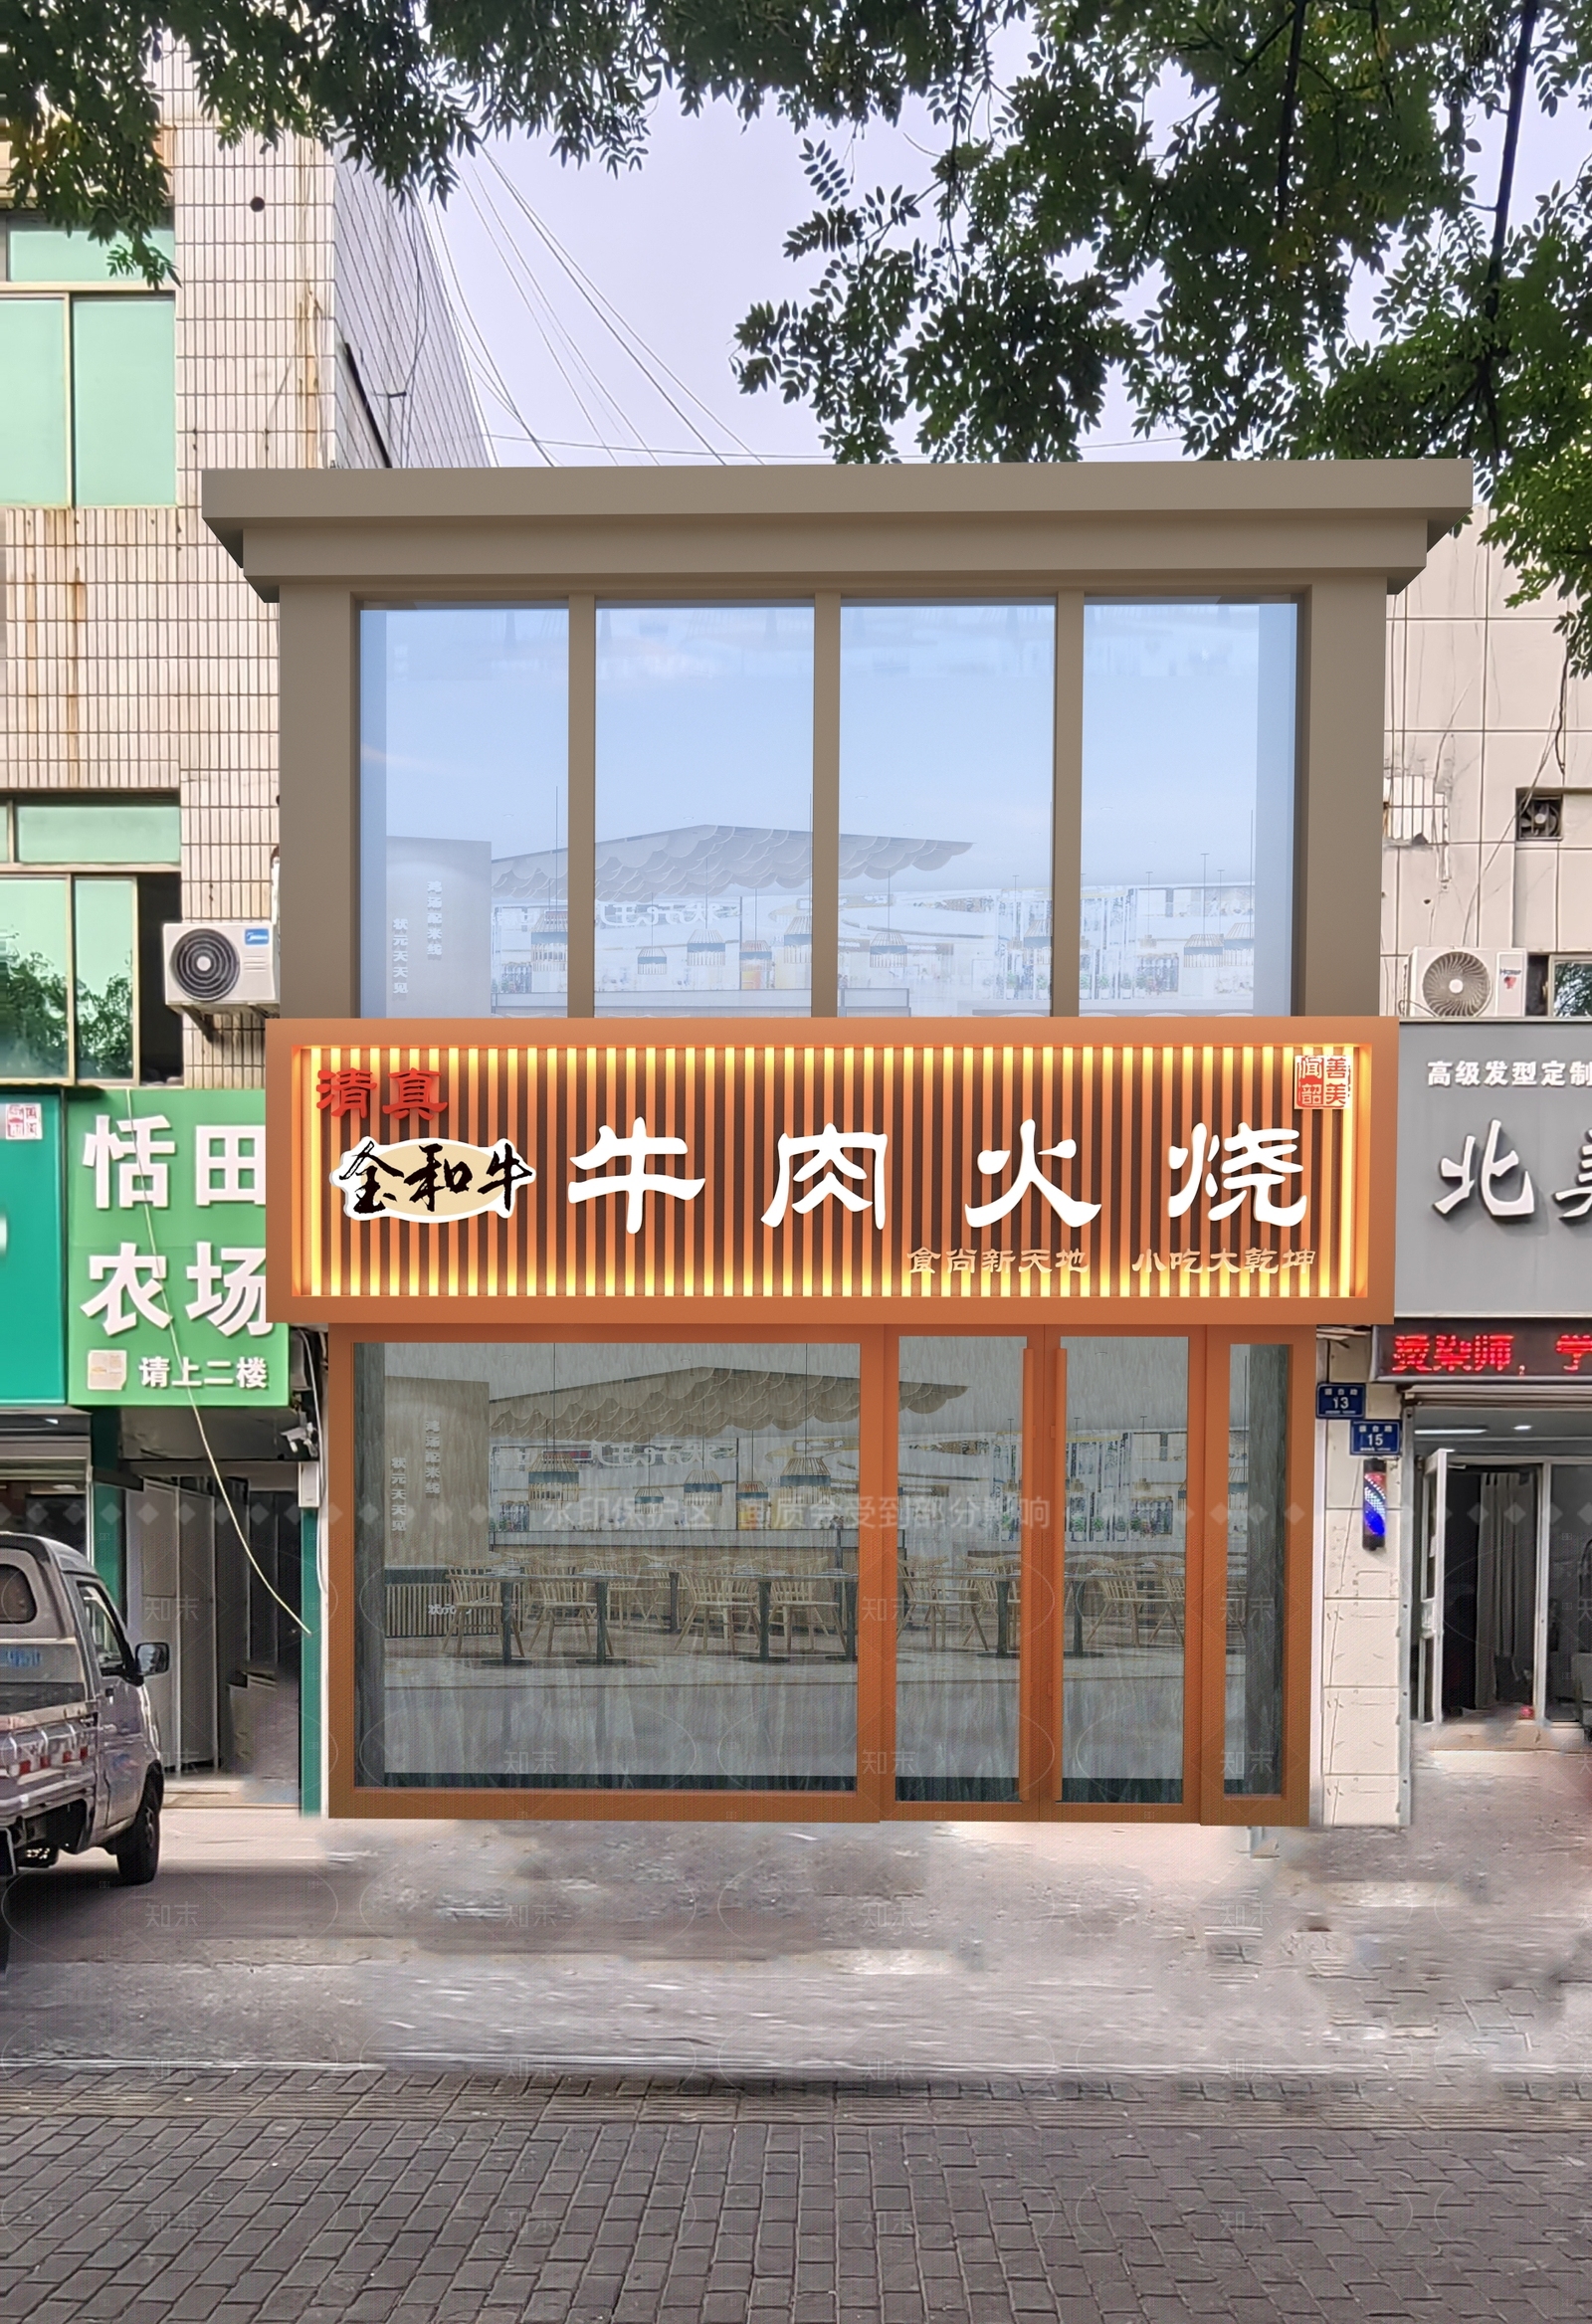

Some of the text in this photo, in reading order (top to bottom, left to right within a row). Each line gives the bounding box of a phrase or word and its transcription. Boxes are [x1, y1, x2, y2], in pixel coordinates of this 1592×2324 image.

[1427, 1061, 1592, 1087] 高级发型定制
[315, 1067, 448, 1120] 清真
[82, 1115, 266, 1209] 恬田
[568, 1116, 1307, 1234] 牛肉火烧
[906, 1247, 1316, 1275] 食尚新天地 小吃大乾坤
[80, 1242, 275, 1337] 农场
[138, 1356, 269, 1389] 请上二楼
[1332, 1397, 1349, 1409] 13
[1367, 1434, 1384, 1446] 15
